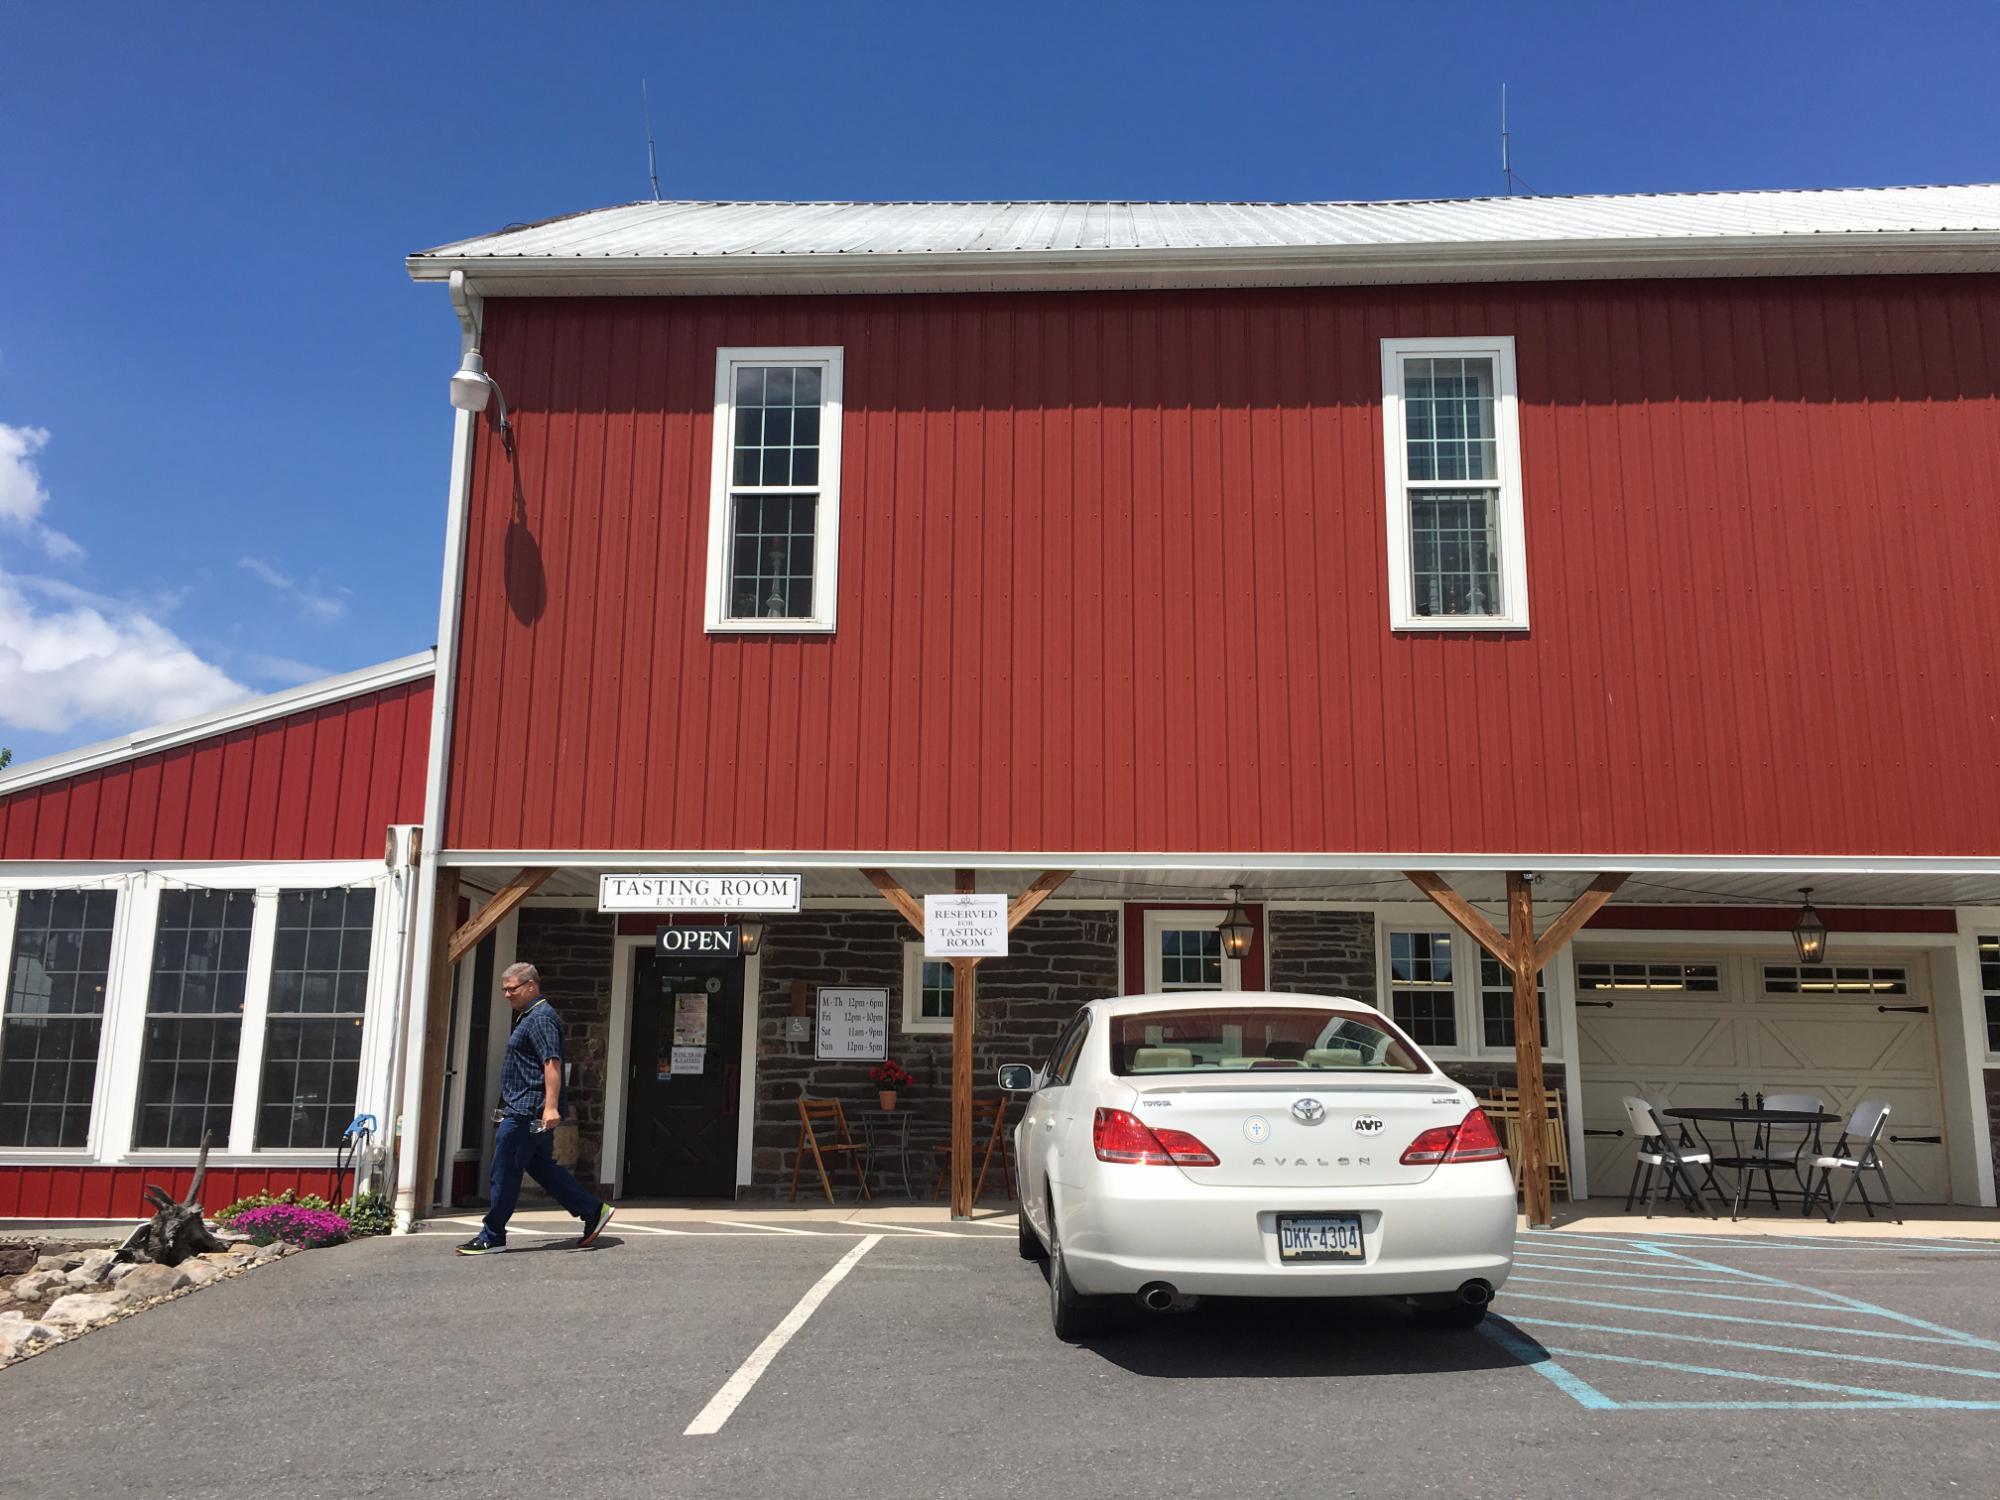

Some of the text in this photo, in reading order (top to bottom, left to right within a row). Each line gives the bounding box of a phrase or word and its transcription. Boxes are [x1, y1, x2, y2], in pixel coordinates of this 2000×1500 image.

[612, 879, 789, 896] TASTING ROOM
[656, 897, 744, 906] ENTRANCE
[934, 910, 998, 919] RESERVED
[938, 927, 993, 937] TASTING
[662, 930, 732, 950] OPEN
[946, 938, 985, 947] ROOM
[848, 998, 865, 1009] 12pm
[869, 998, 884, 1008] 6pm
[822, 1012, 832, 1021] Fri
[844, 1012, 862, 1023] 12pm
[820, 1027, 831, 1036] Sat
[868, 1027, 883, 1038] 9pm
[820, 1042, 833, 1051] Sun
[847, 1042, 864, 1053] 12pm
[1252, 1157, 1371, 1166] AVALON
